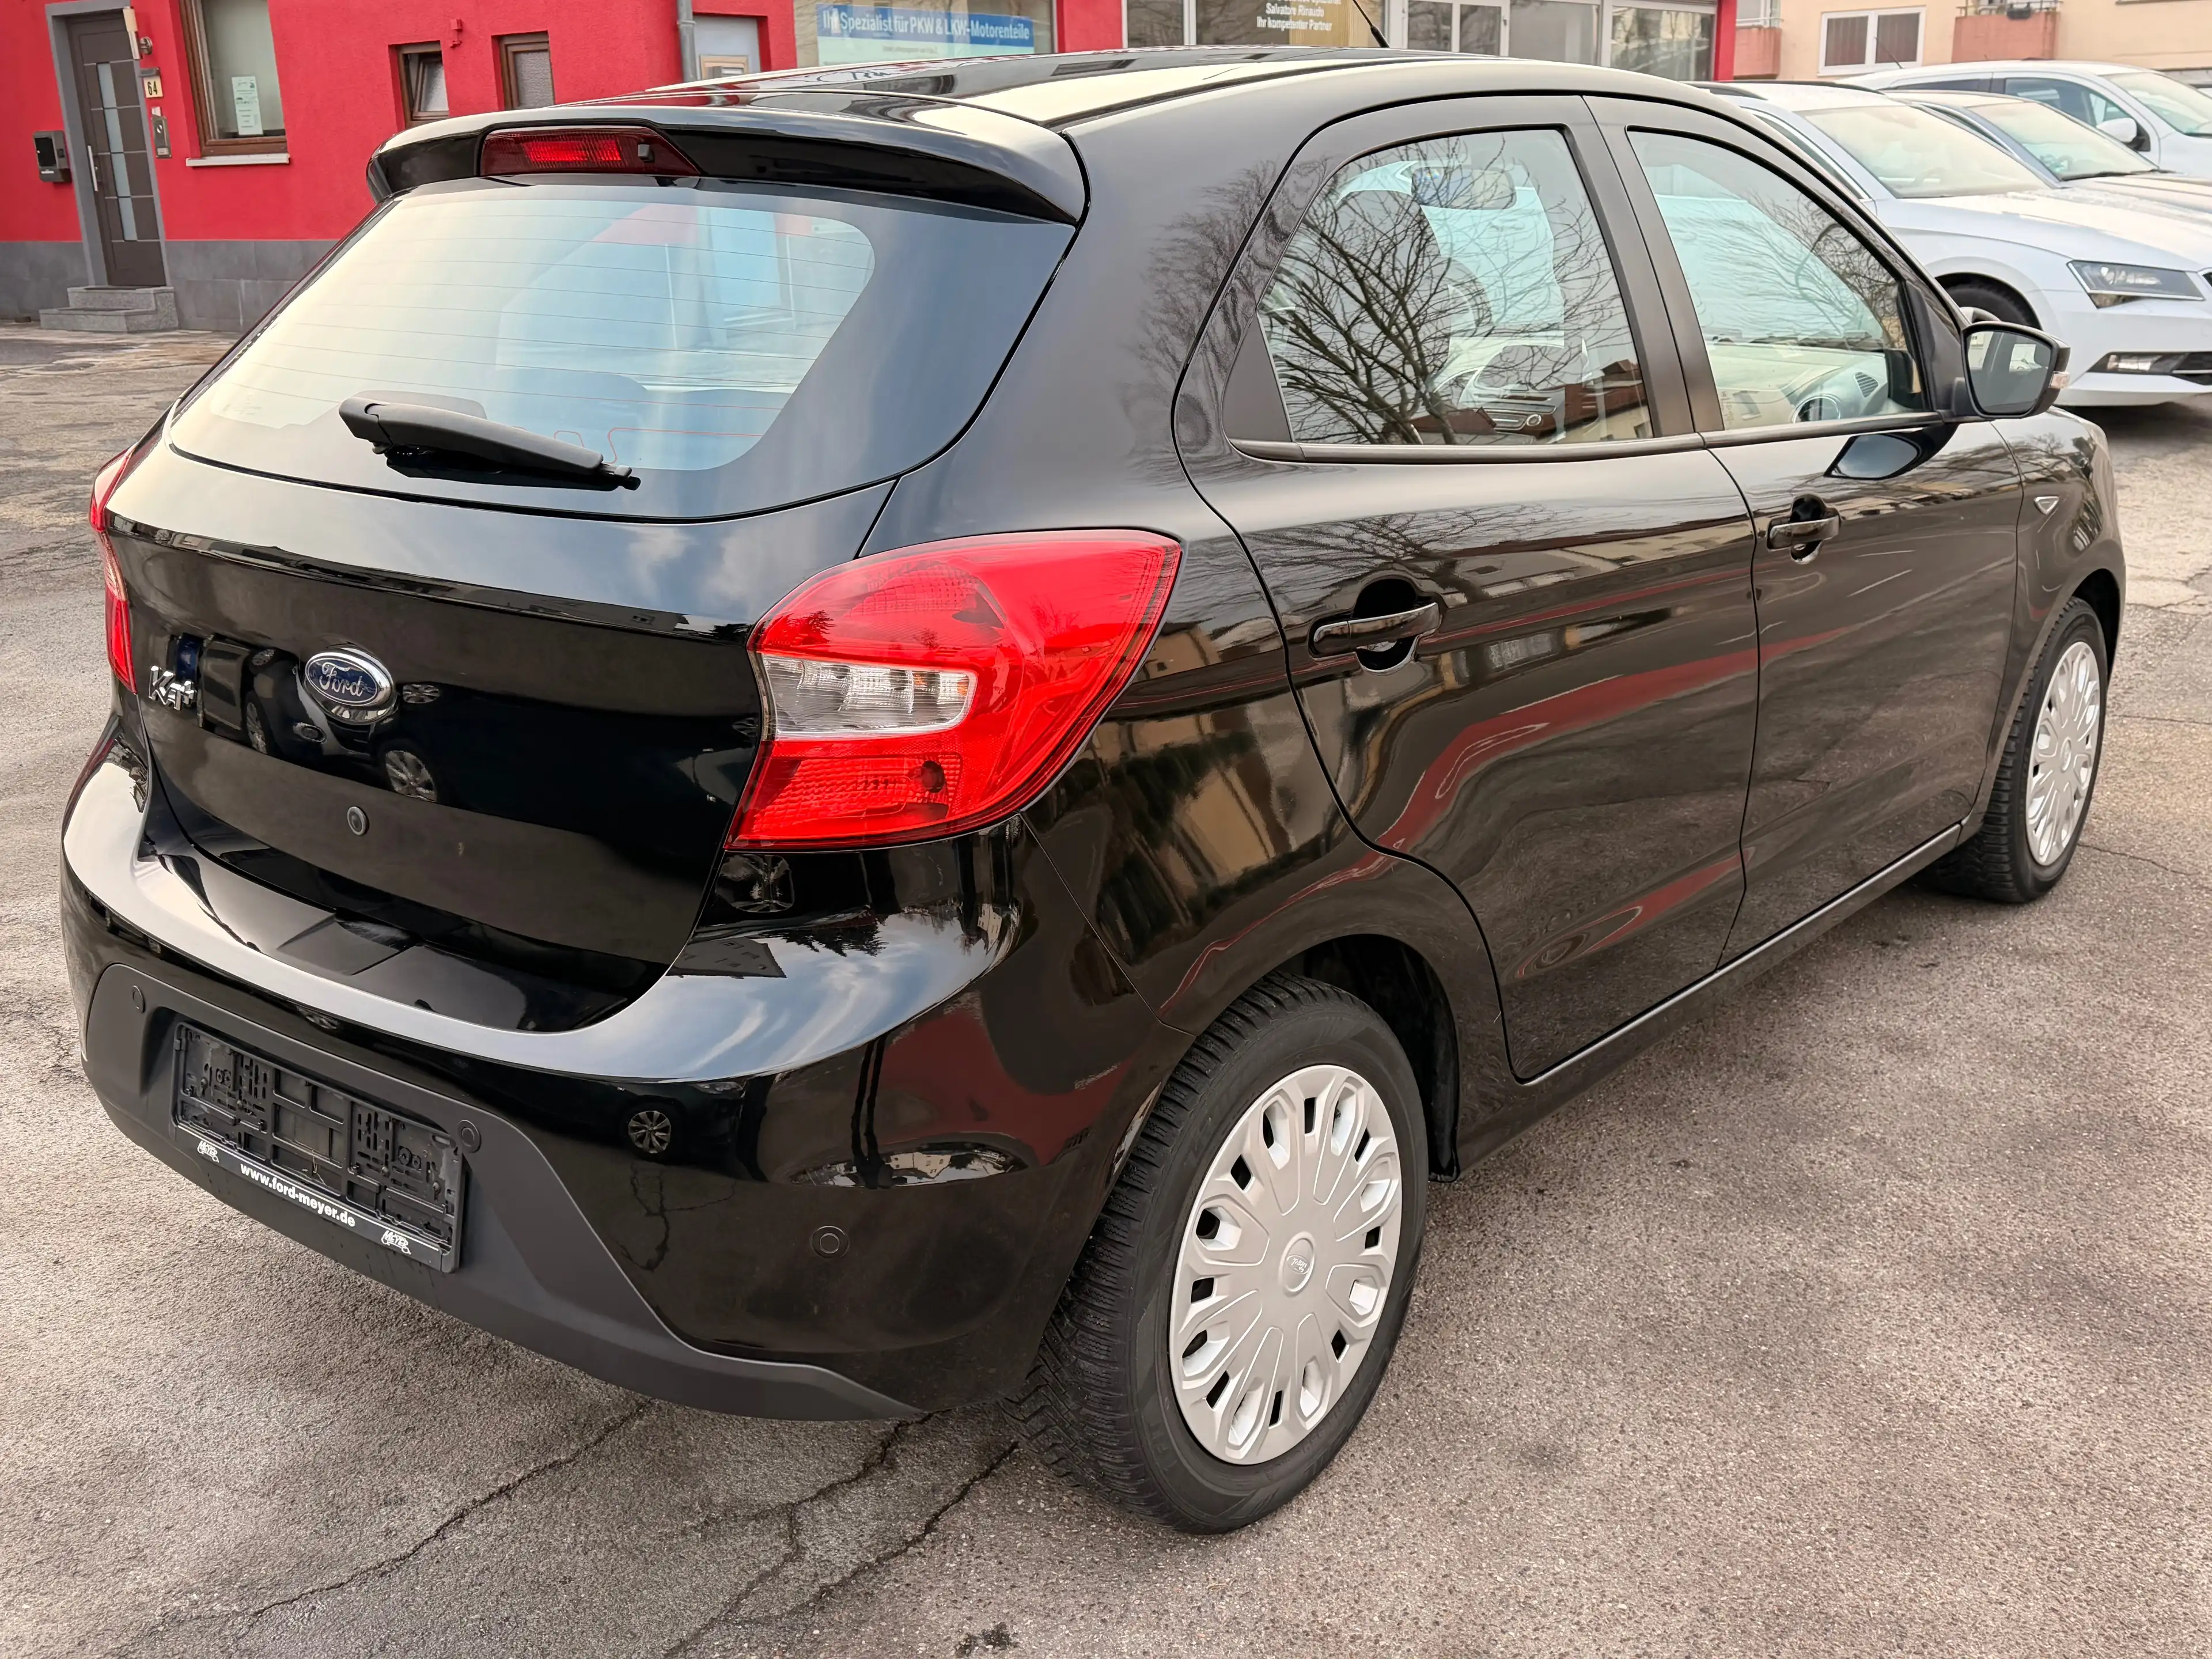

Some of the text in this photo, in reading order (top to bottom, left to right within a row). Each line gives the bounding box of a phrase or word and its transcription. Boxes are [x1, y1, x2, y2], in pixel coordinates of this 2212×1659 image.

[840, 12, 892, 32] Spezialist
[893, 17, 909, 33] für
[910, 17, 934, 33] PKW
[935, 19, 943, 35] &
[945, 19, 1031, 40] LKW-Motorenteile
[147, 81, 158, 96] 64
[319, 662, 363, 697] Ford
[240, 1164, 355, 1227] www.ford-meyer.de
